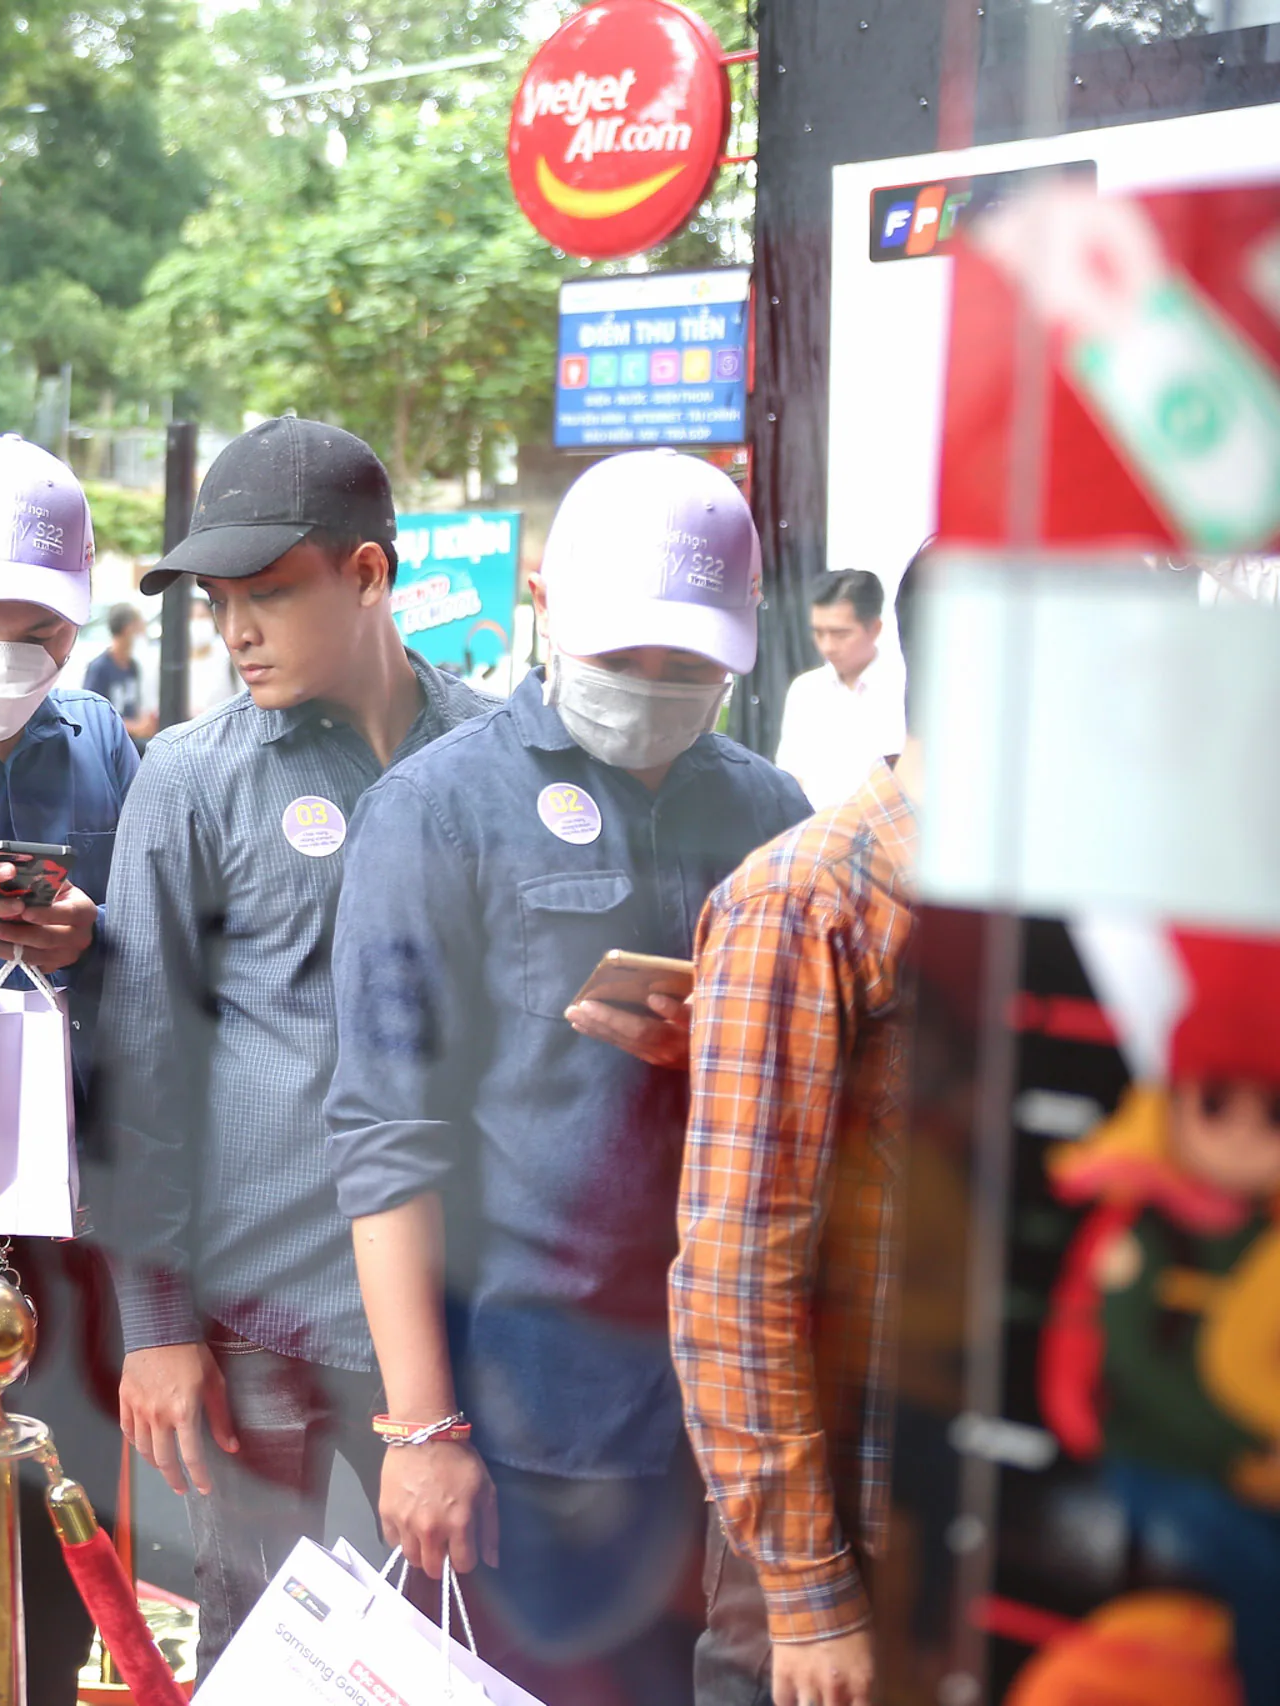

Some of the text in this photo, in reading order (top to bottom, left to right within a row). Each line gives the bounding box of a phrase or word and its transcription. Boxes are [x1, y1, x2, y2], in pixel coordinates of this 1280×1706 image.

[885, 202, 968, 238] FPT
[635, 319, 676, 344] THU
[35, 521, 64, 545] S22
[690, 553, 724, 579] S22
[297, 802, 329, 826] 03
[549, 790, 584, 813] 02
[275, 1622, 334, 1681] Samsung
[335, 1675, 370, 1706] Gala
